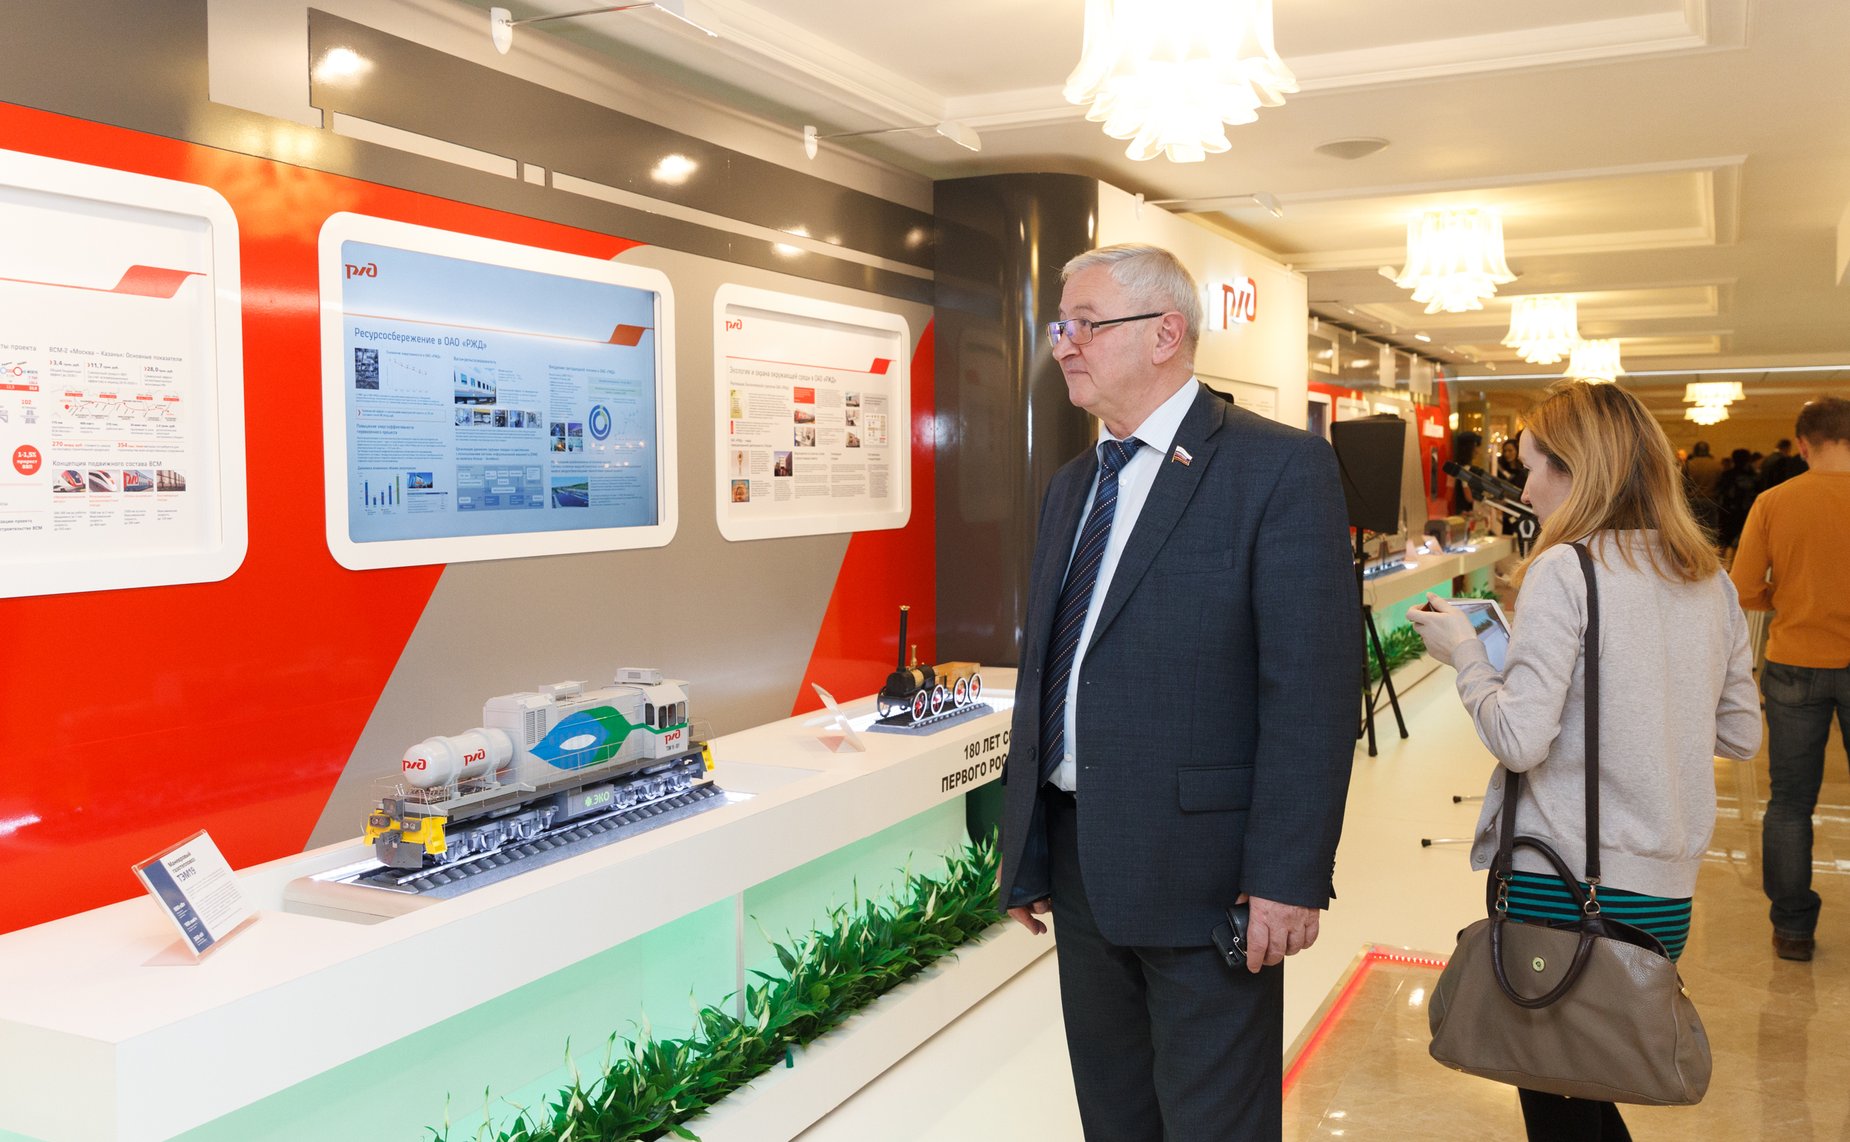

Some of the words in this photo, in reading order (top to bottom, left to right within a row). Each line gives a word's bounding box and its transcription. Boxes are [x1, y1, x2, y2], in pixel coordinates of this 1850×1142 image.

[354, 327, 436, 345] Ресурсосбережение
[444, 336, 460, 347] ОАО
[462, 339, 487, 350] «РЖД»
[964, 741, 980, 760] 180
[983, 734, 1000, 753] ЛЕТ
[942, 762, 987, 792] ПЕРВОГО
[592, 791, 610, 805] ЭКО
